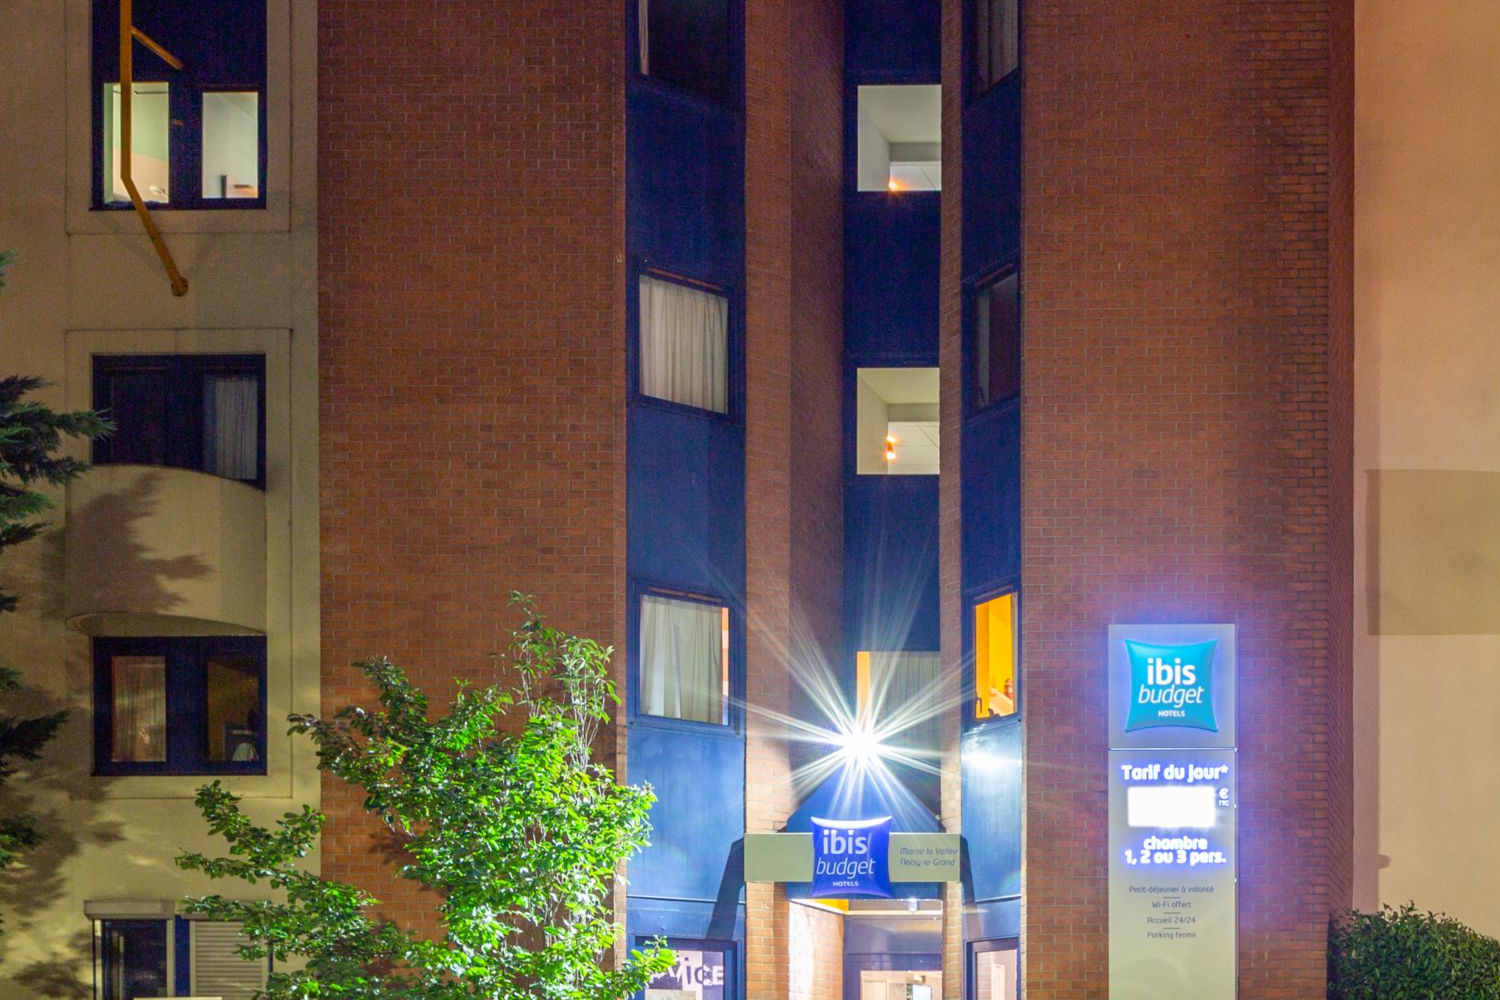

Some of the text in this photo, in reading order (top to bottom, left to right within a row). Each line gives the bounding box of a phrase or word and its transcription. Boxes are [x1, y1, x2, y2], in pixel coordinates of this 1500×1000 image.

[1147, 657, 1197, 686] ibis
[1138, 684, 1205, 708] budget
[1158, 710, 1186, 718] HOTELS
[1121, 764, 1161, 781] Tarif
[1163, 764, 1186, 780] du
[823, 829, 868, 855] ibis
[1143, 835, 1208, 851] chambre
[1140, 850, 1151, 864] 2
[1153, 851, 1174, 864] ou
[1176, 850, 1187, 864] 3
[1189, 852, 1227, 867] pers.
[816, 857, 876, 879] budget
[1174, 916, 1196, 924] 24/24
[1147, 931, 1174, 940] Parking
